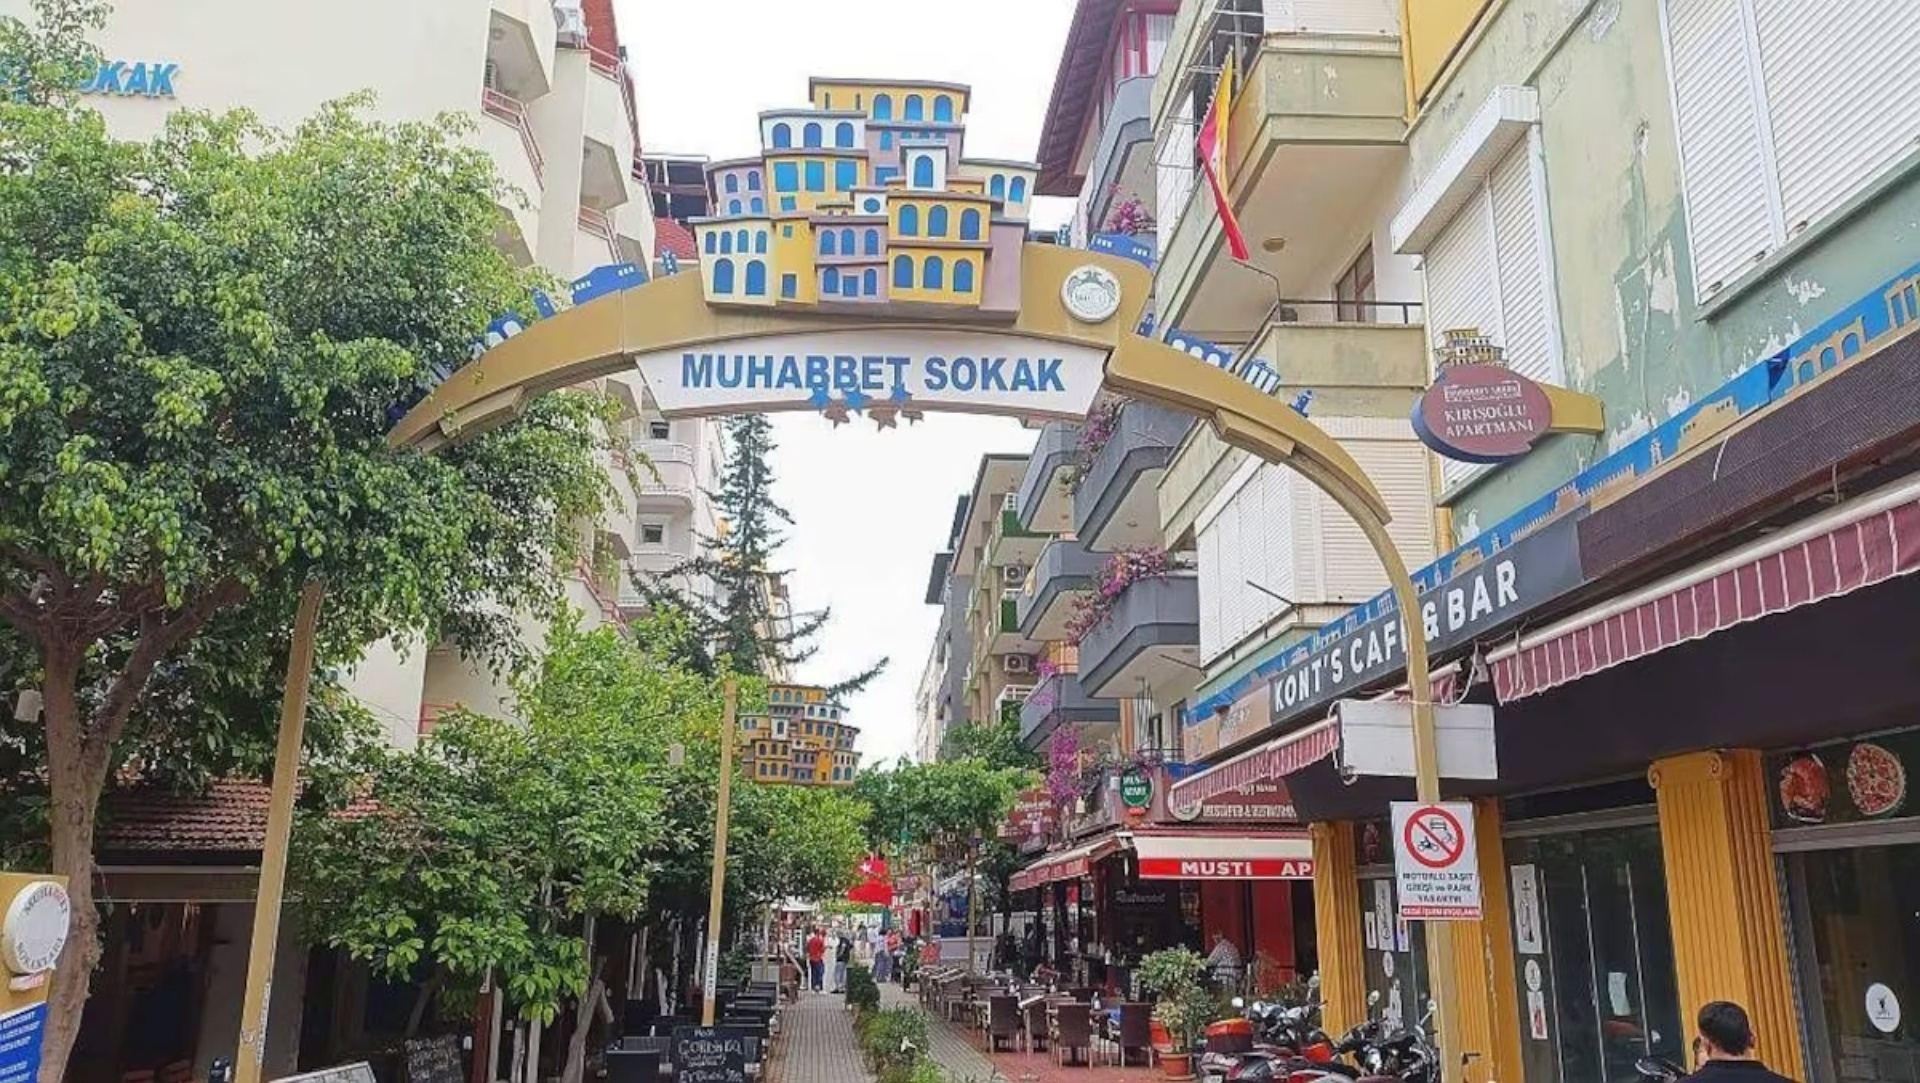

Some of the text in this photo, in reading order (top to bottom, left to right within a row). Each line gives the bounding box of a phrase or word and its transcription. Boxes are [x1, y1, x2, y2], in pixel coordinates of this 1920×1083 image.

[681, 353, 1065, 392] MUHABBET SOKAK
[1445, 418, 1534, 437] APARTMANI
[1274, 648, 1344, 713] KONT'S
[1421, 600, 1441, 642] &
[1447, 560, 1519, 632] BAR
[1281, 861, 1315, 876] AP
[1447, 883, 1473, 892] PARK
